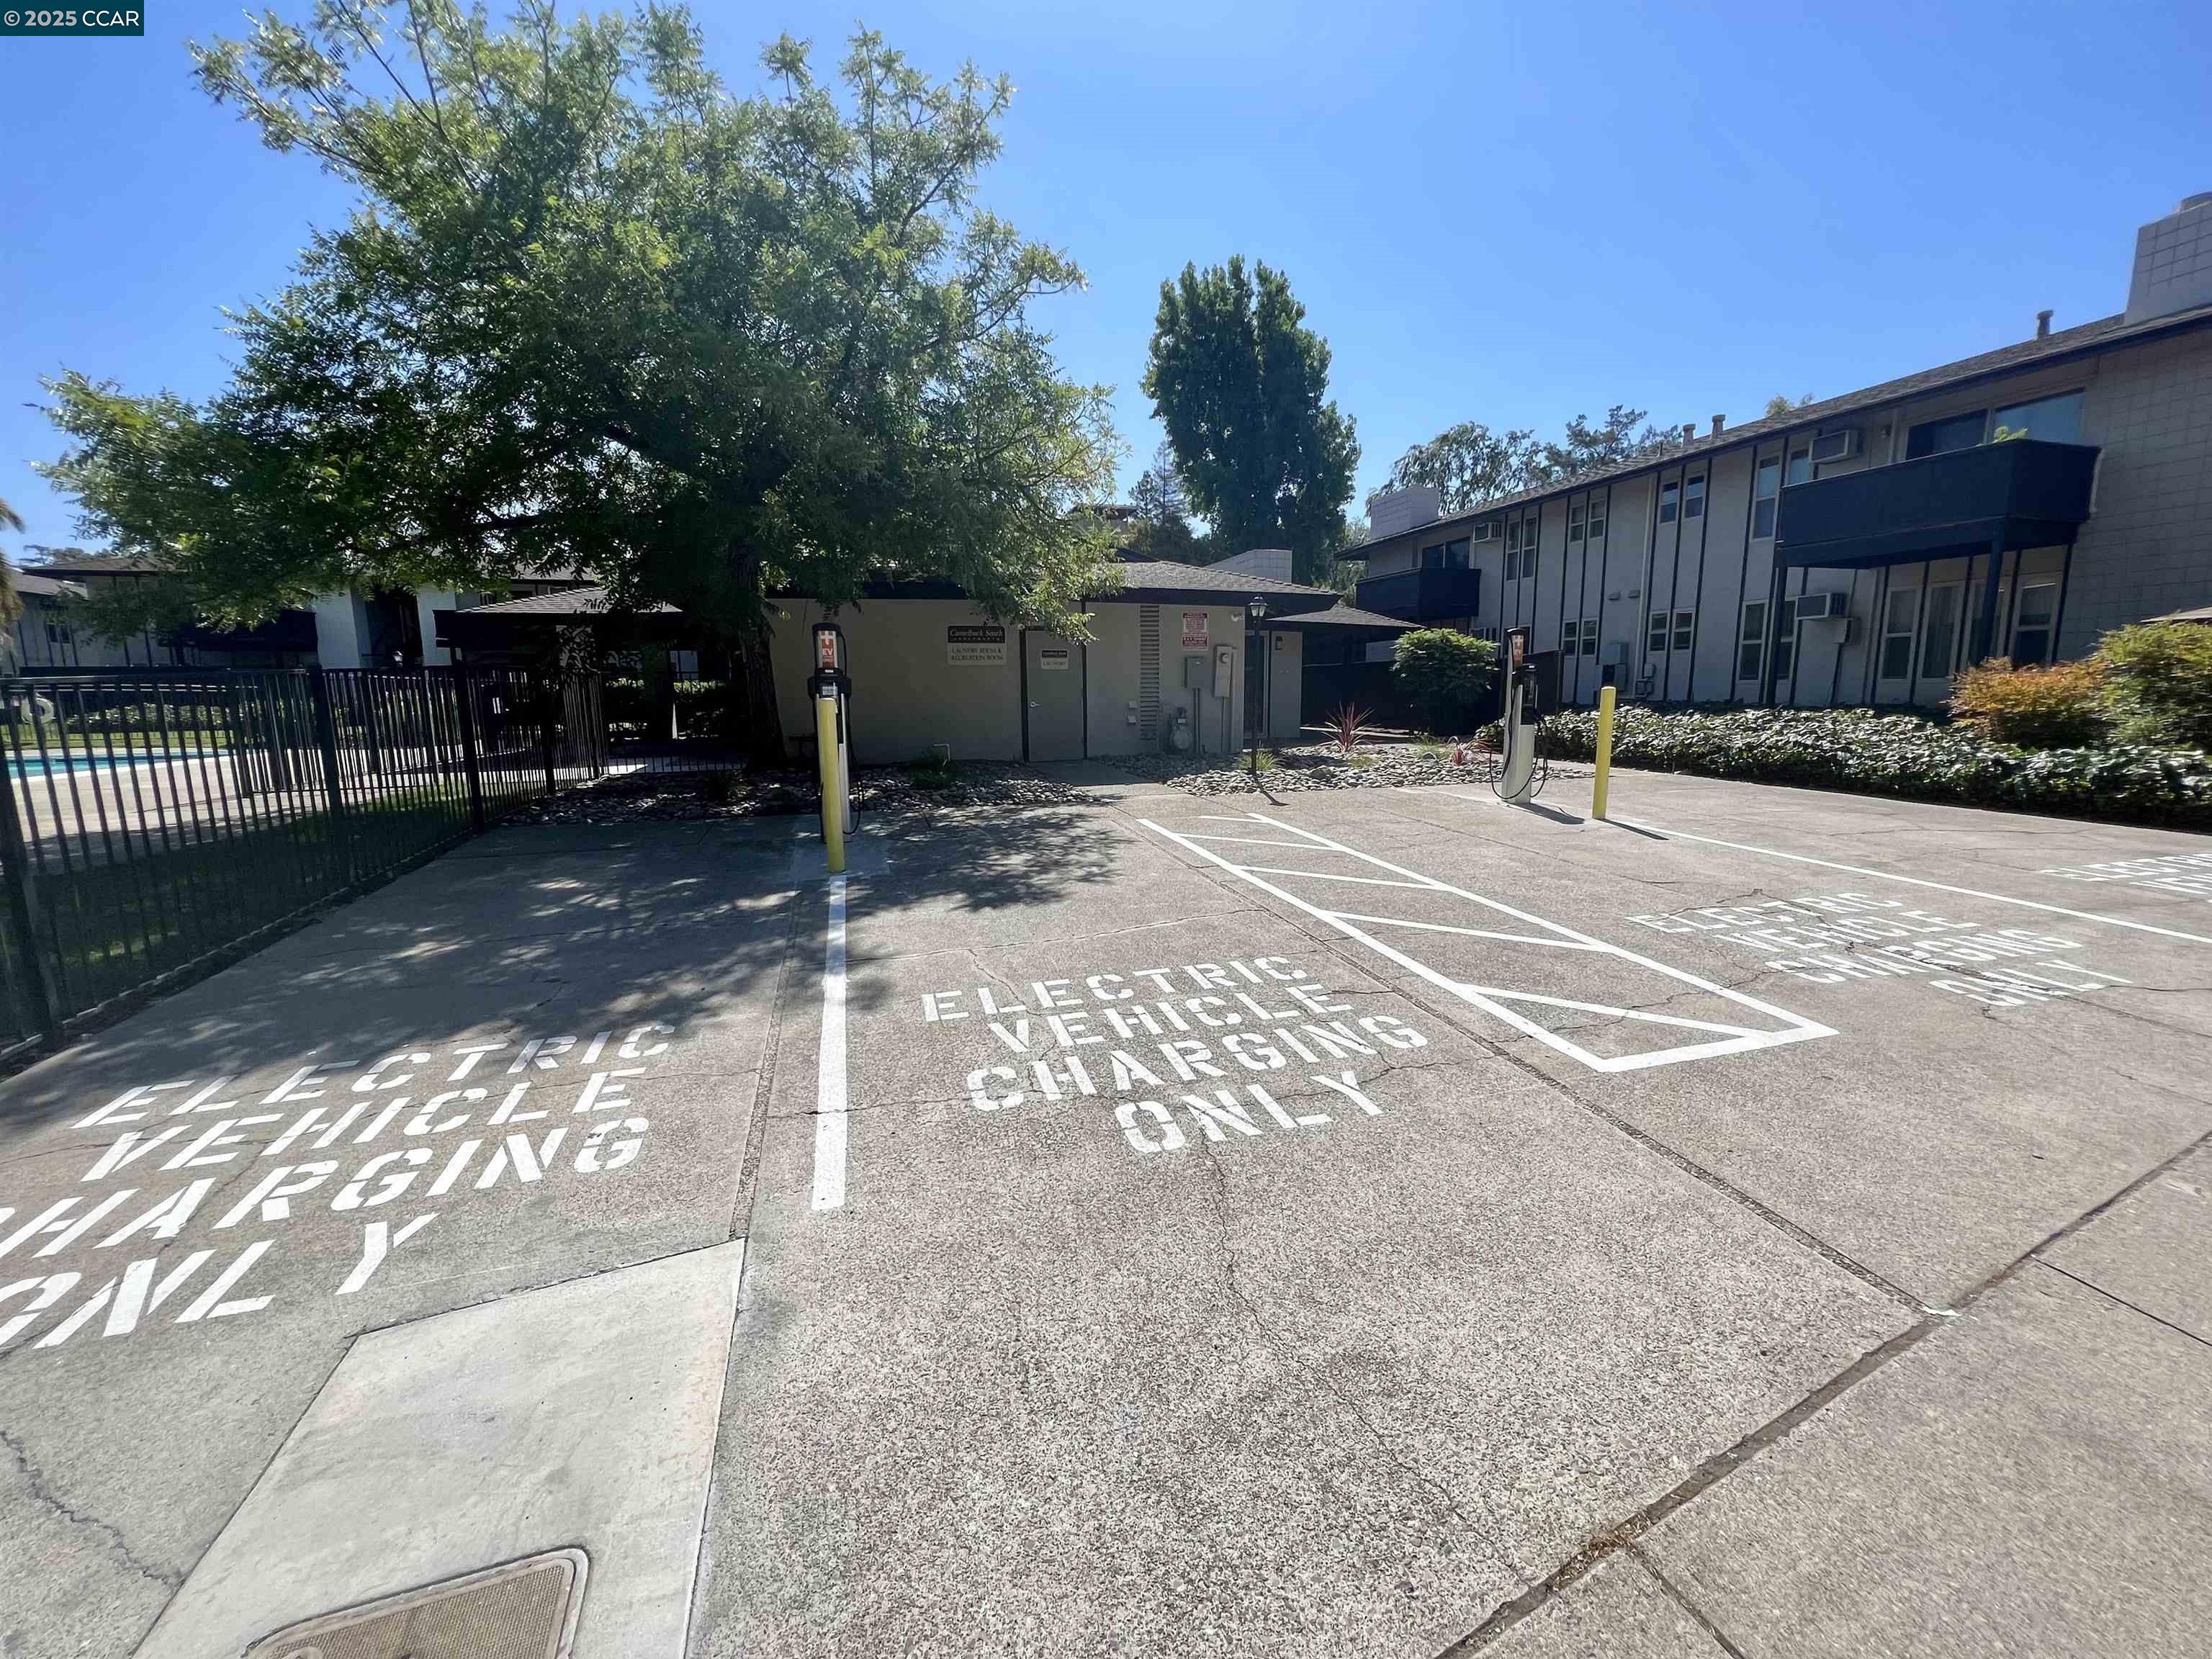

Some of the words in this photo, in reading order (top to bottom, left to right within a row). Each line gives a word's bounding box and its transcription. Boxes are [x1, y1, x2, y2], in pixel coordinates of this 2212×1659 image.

[1624, 893, 1902, 933] ELECTRIC
[1712, 910, 1982, 952] VEHICLE
[922, 956, 1308, 1022] ELECTRIC
[1765, 929, 2083, 983] CHARGING
[1930, 959, 2133, 1006] ONLY
[987, 984, 1353, 1053] VEHICLE
[72, 1023, 675, 1129] ELECTRIC
[966, 1015, 1429, 1112] CHARGING
[81, 1067, 645, 1182] VEHICLE
[1114, 1071, 1384, 1153] ONLY
[0, 1117, 649, 1259] HARGING
